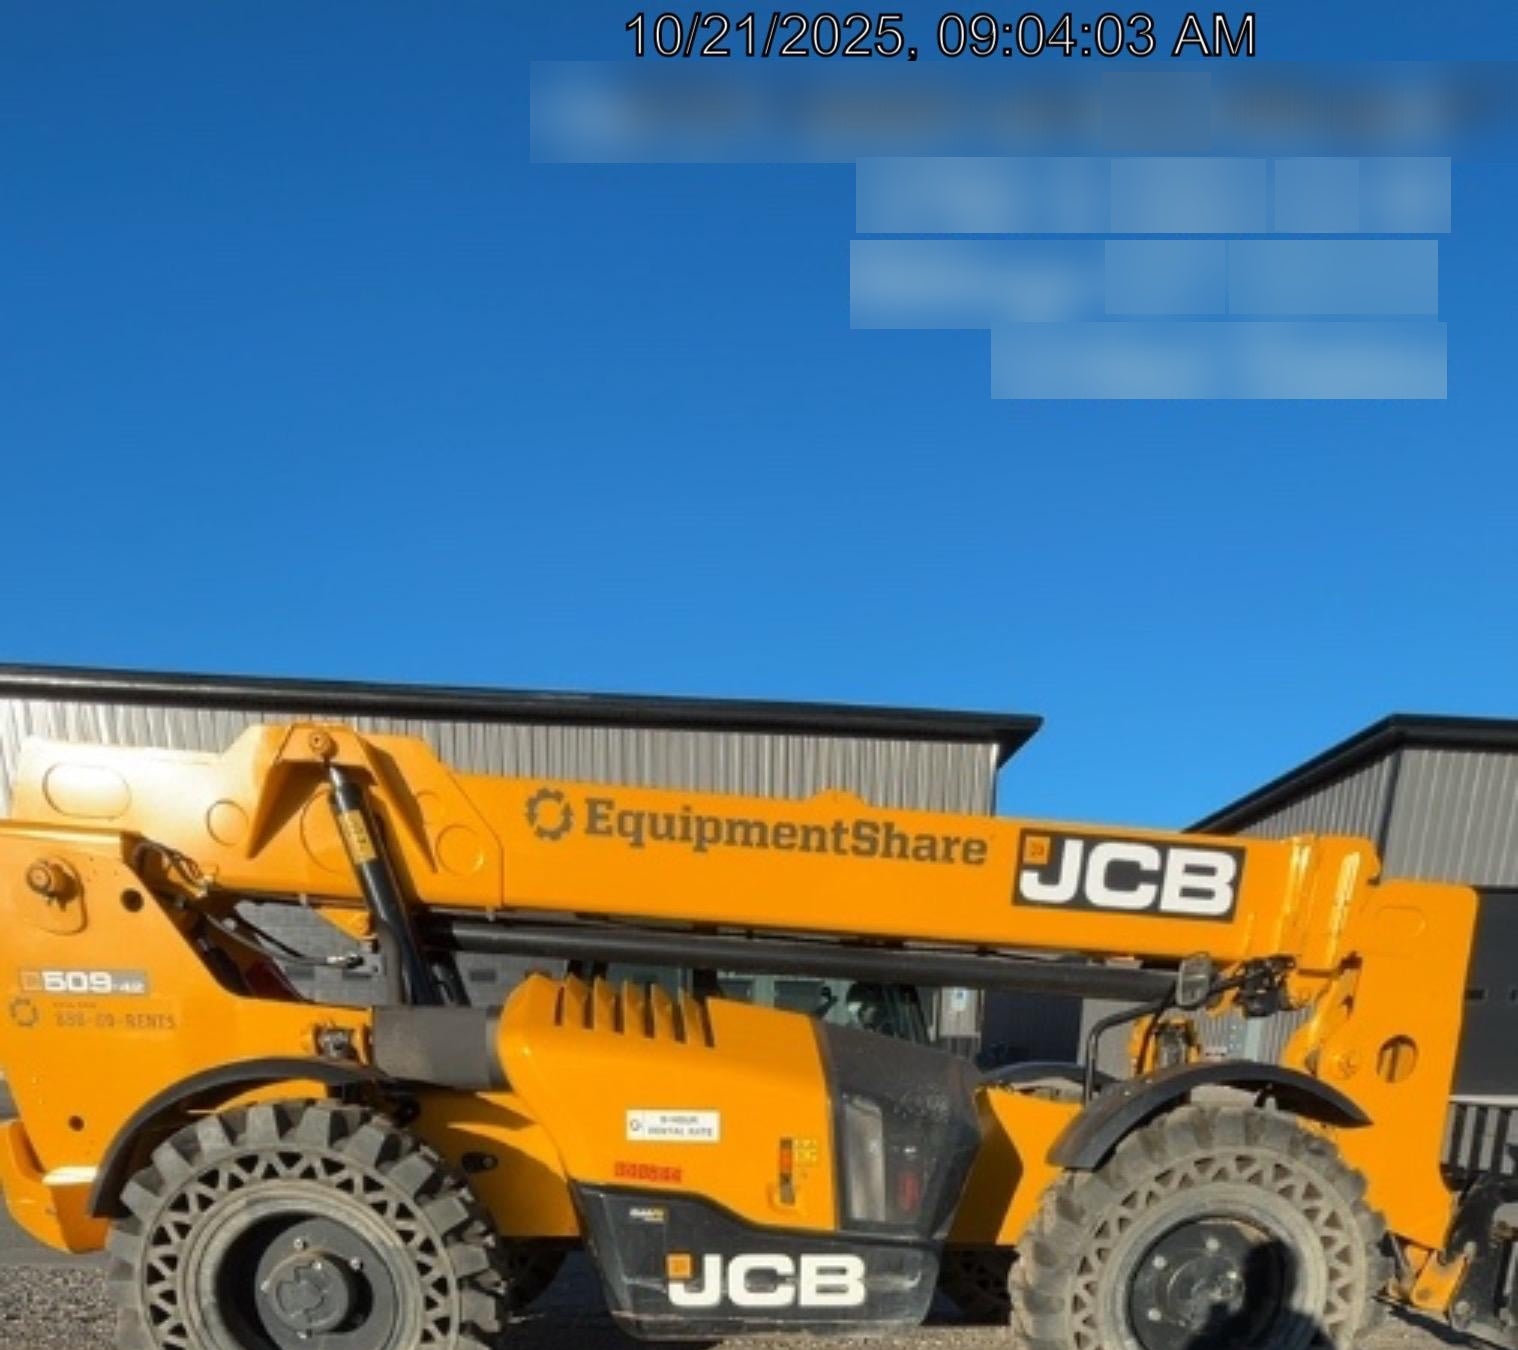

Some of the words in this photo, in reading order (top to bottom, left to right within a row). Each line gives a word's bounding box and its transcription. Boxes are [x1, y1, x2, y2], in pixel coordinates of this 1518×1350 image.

[583, 797, 988, 865] EquipmentShare
[1019, 838, 1238, 917] JCB
[667, 1253, 865, 1307] JCB
